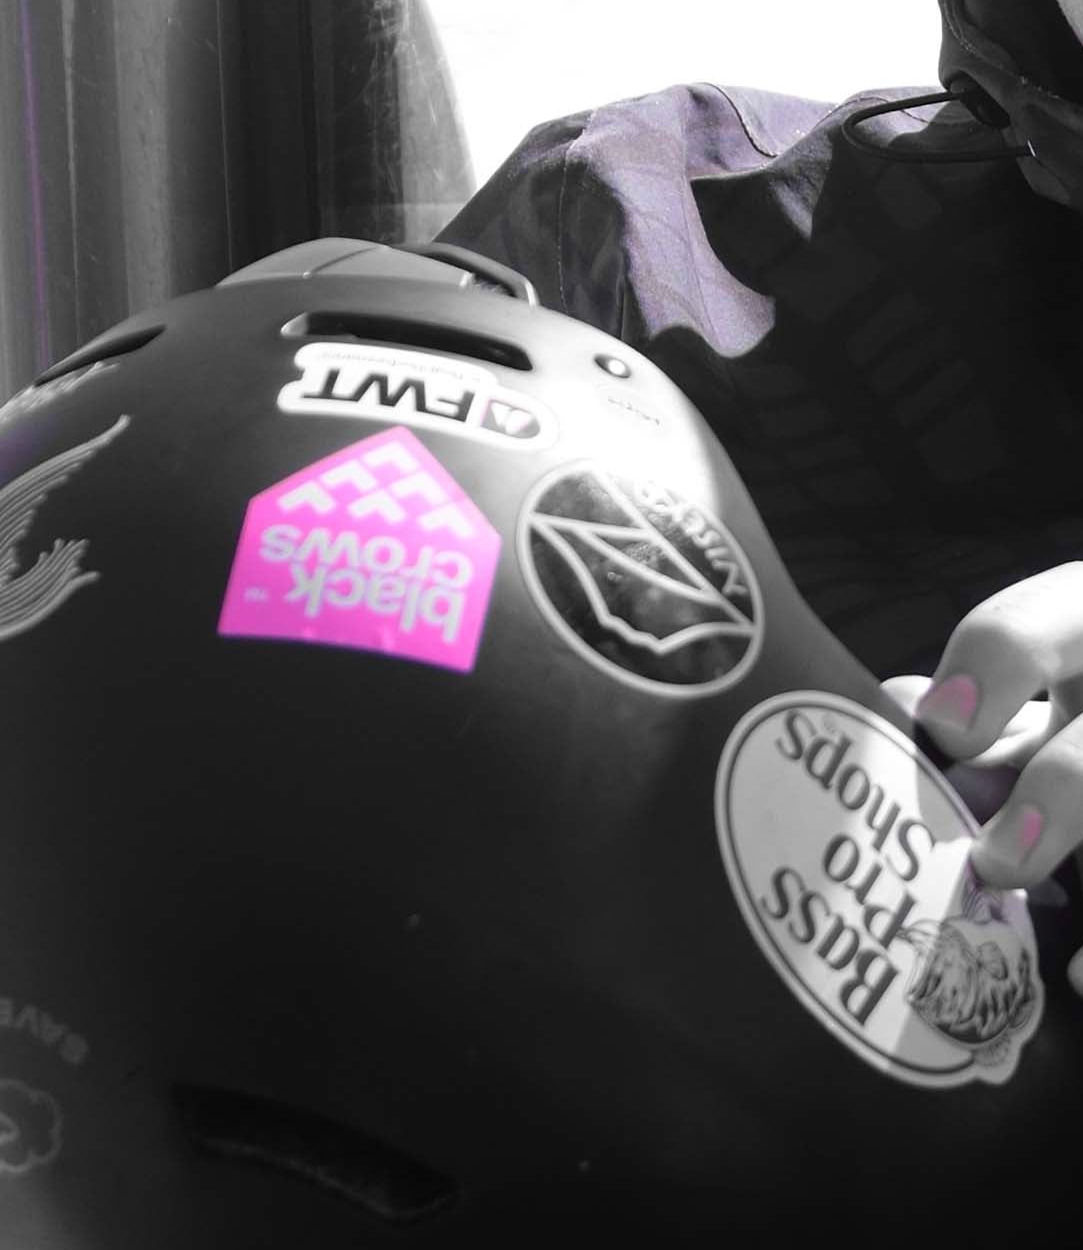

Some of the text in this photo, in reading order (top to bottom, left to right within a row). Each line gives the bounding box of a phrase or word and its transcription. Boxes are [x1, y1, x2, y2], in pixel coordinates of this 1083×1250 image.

[300, 368, 475, 422] FWT
[259, 524, 473, 588] crows
[285, 562, 465, 643] black
[775, 710, 937, 881] Shops
[823, 832, 918, 949] Pro
[761, 866, 898, 1026] Bass
